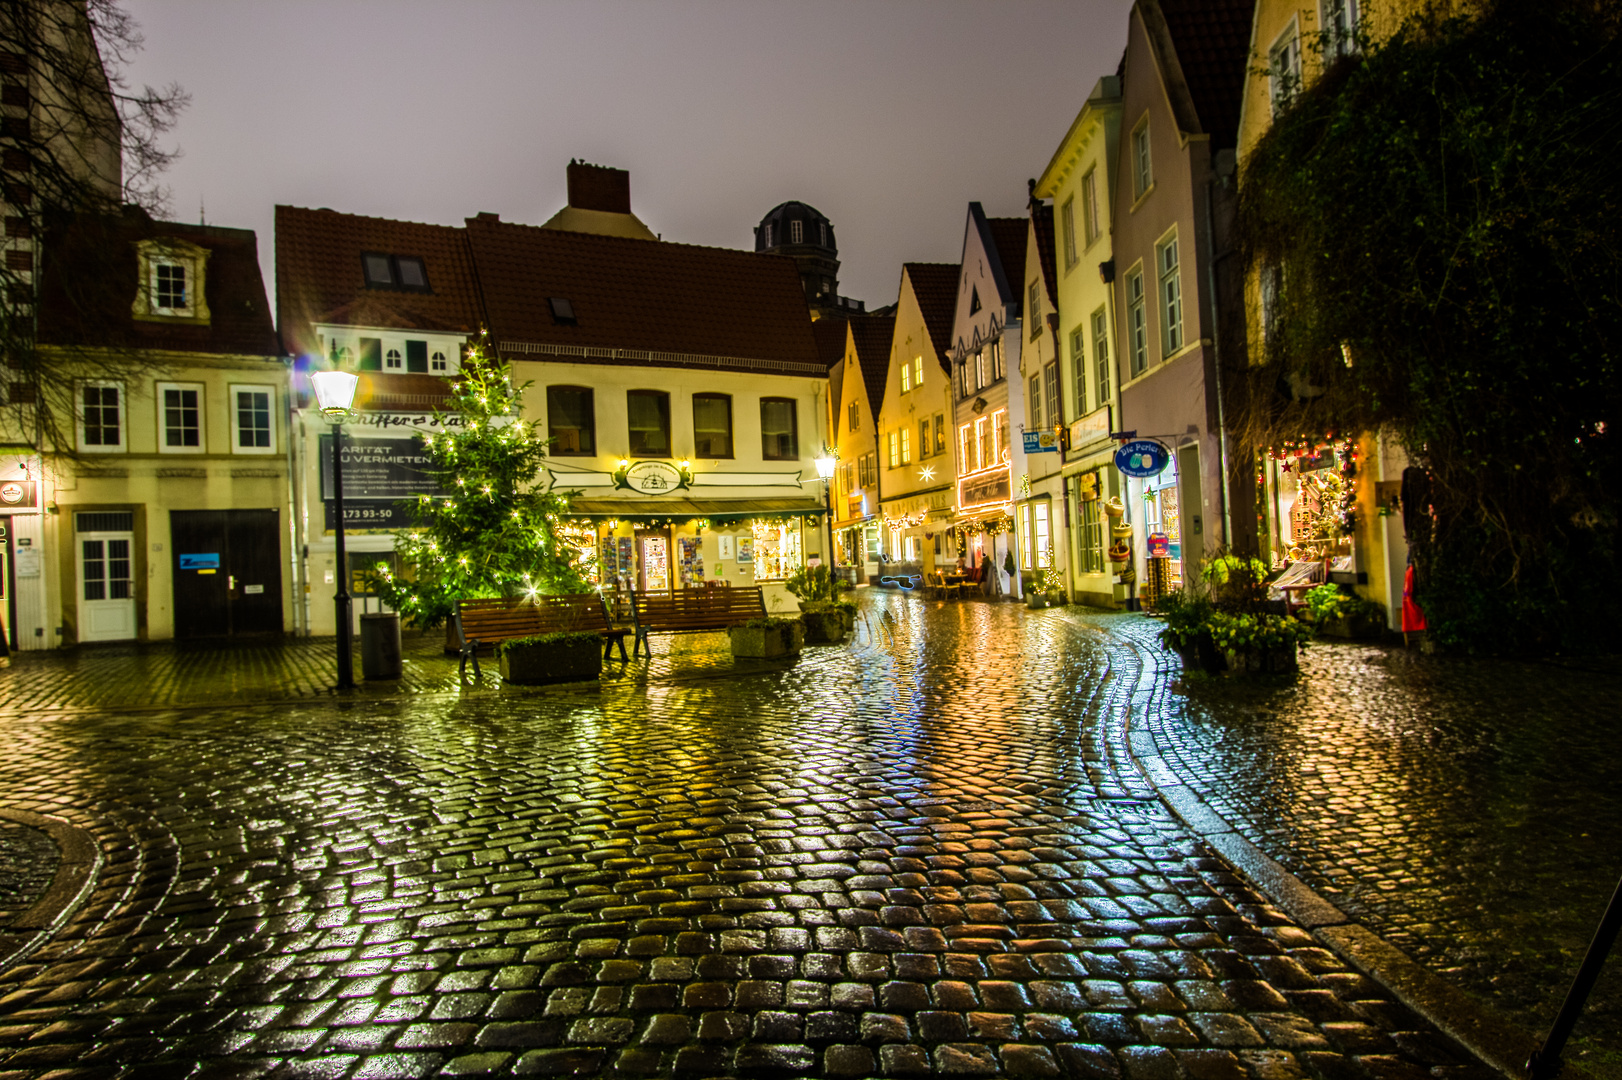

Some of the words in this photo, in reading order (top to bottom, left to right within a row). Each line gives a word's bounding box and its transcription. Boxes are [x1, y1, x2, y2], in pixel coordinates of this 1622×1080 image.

[347, 412, 411, 428] chiffer
[1023, 434, 1038, 443] EIS
[1120, 445, 1134, 457] Die
[1135, 443, 1166, 458] Perlerie
[353, 455, 432, 464] VERMIETEN
[343, 509, 360, 518] 173
[362, 509, 392, 518] 93-50
